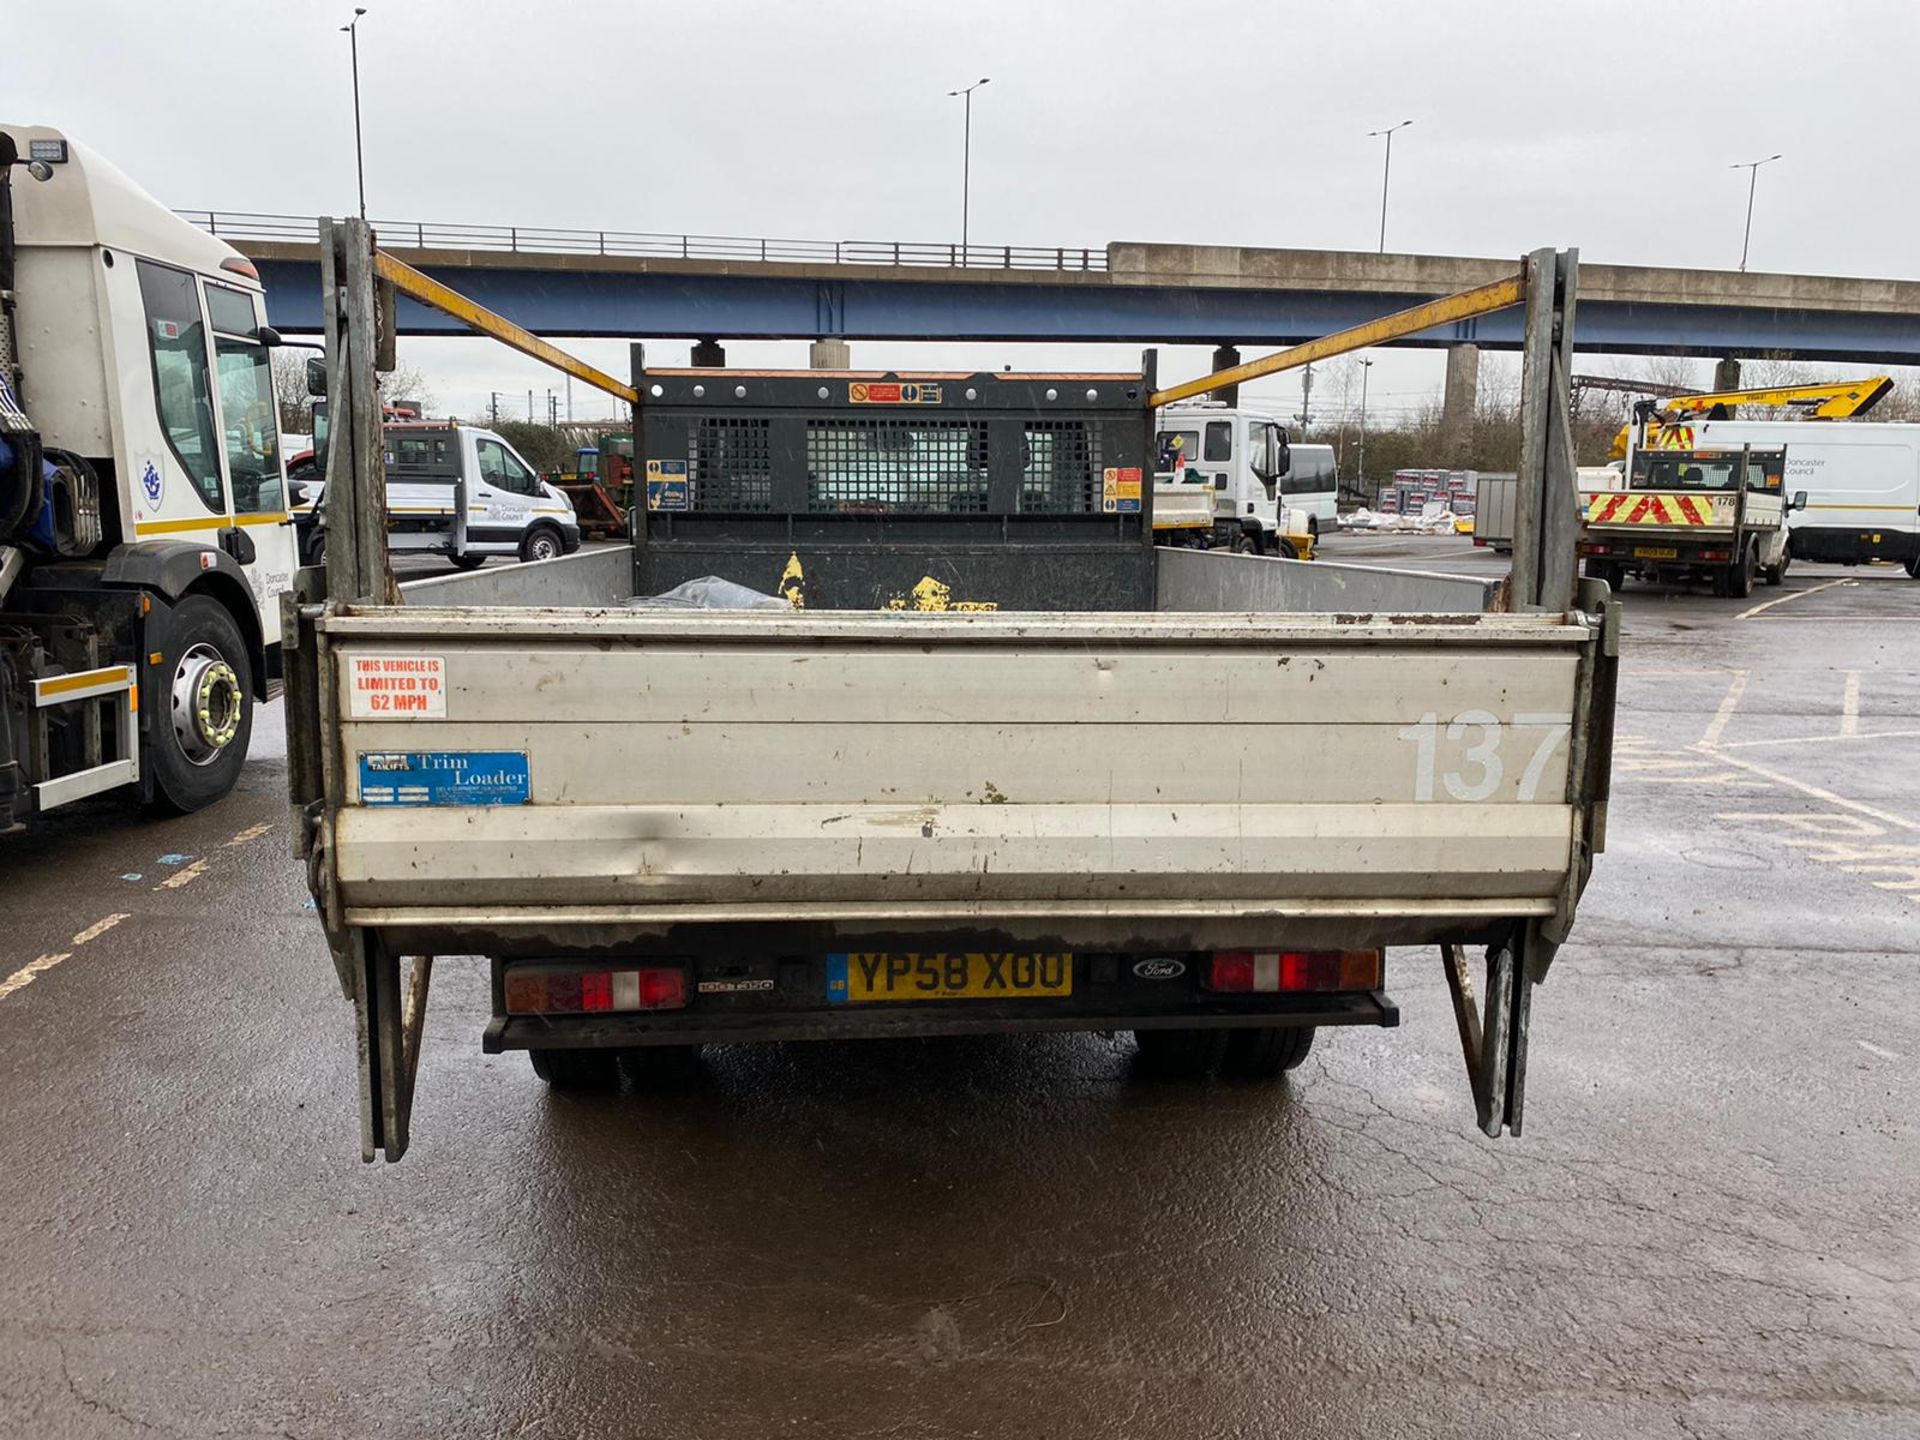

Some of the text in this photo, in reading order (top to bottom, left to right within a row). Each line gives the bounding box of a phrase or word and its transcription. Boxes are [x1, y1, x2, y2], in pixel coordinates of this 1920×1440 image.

[1716, 497, 1735, 507] 178
[356, 660, 439, 672] THIS VEHICLE IS
[357, 677, 438, 690] LIMITED TO
[370, 694, 427, 710] 62 MPH
[416, 754, 469, 770] Trim
[1397, 709, 1572, 803] 137
[454, 770, 526, 786] Loader
[857, 952, 969, 992] YP58
[830, 980, 845, 991] GB
